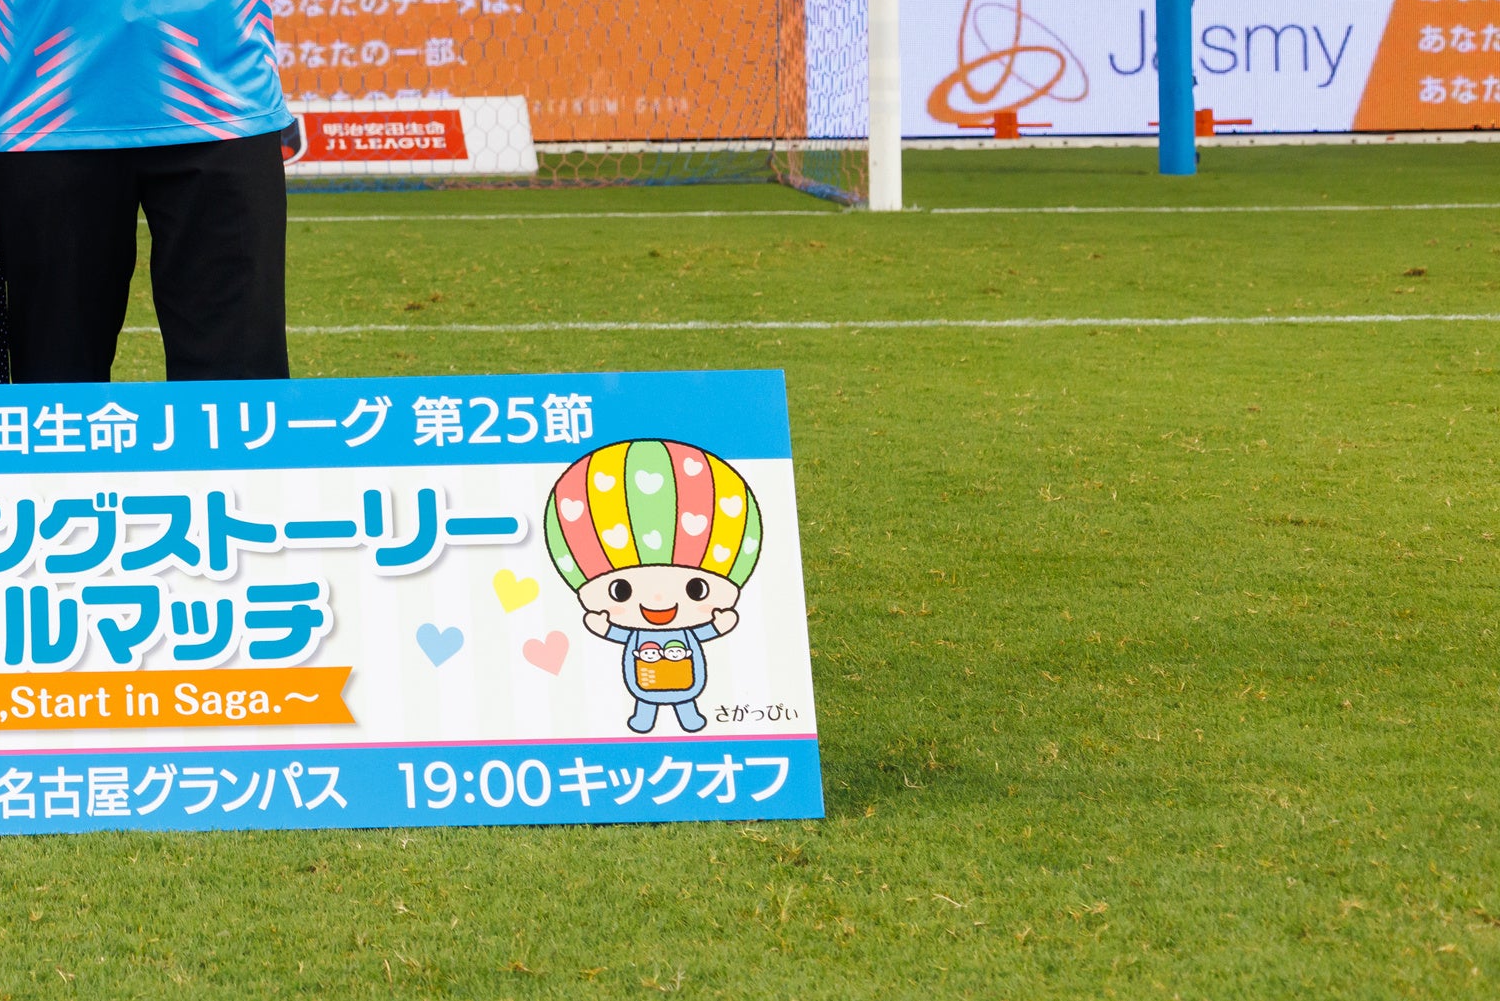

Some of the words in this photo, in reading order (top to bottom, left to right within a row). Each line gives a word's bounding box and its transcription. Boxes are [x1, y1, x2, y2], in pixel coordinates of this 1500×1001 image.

[275, 37, 467, 68] あなたの一部、
[1108, 9, 1353, 87] Jsmy
[353, 137, 447, 150] LEAGUE
[412, 392, 594, 447] 第25節
[122, 685, 162, 716] in
